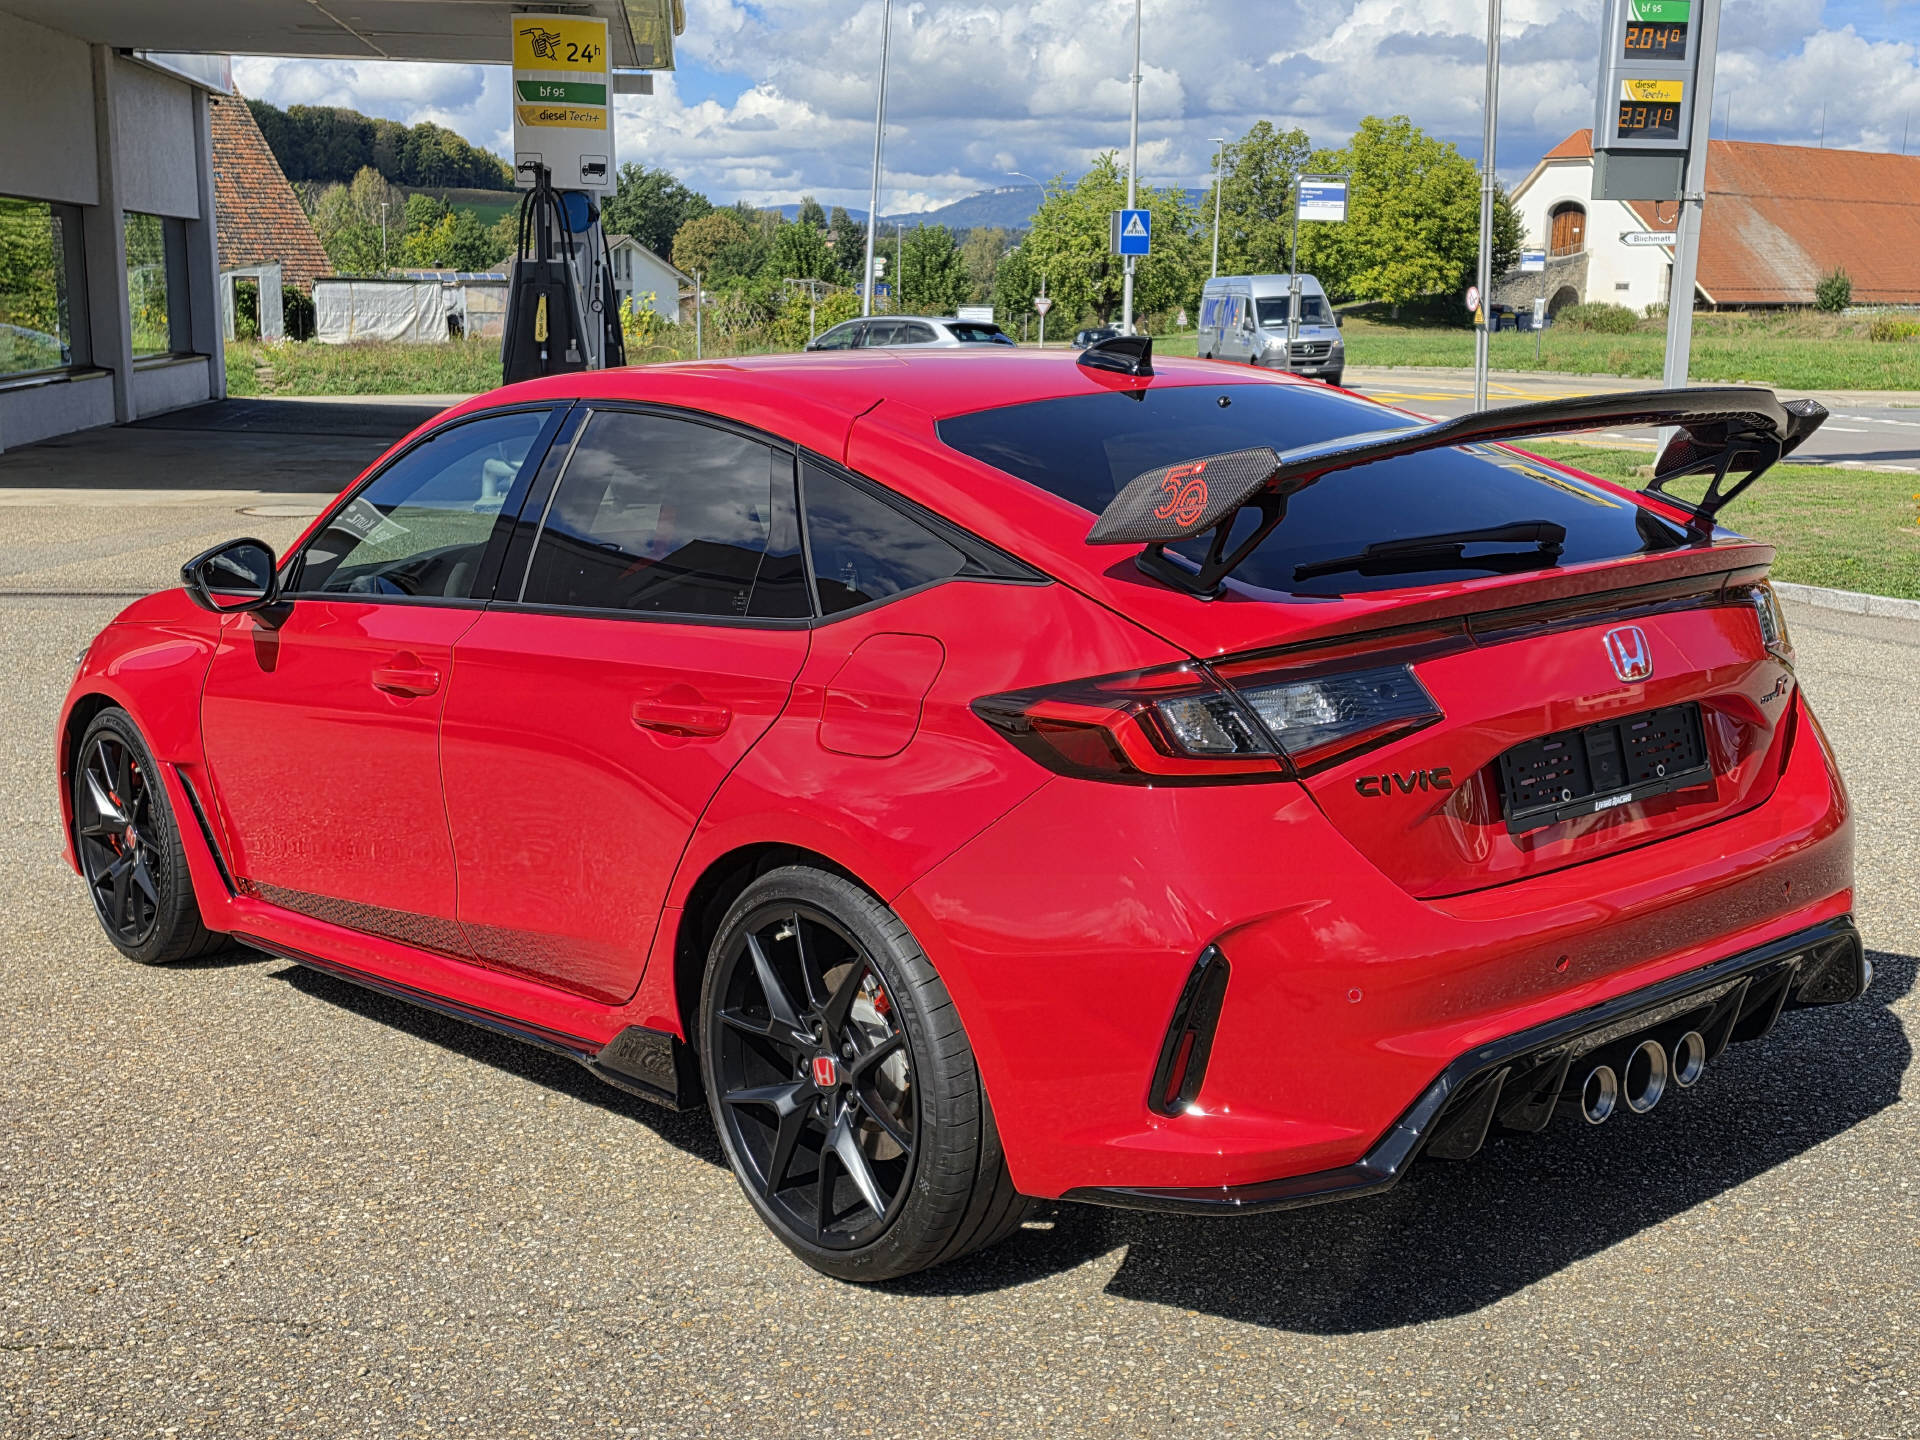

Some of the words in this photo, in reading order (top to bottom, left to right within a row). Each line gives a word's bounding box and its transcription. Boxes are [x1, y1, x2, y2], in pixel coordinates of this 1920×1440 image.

[1641, 3, 1651, 13] bf
[1635, 79, 1657, 89] diesel
[540, 86, 551, 97] bf
[553, 88, 565, 97] 95
[540, 110, 567, 121] diesel
[568, 110, 600, 123] Tech+
[1355, 767, 1453, 798] CIVIC
